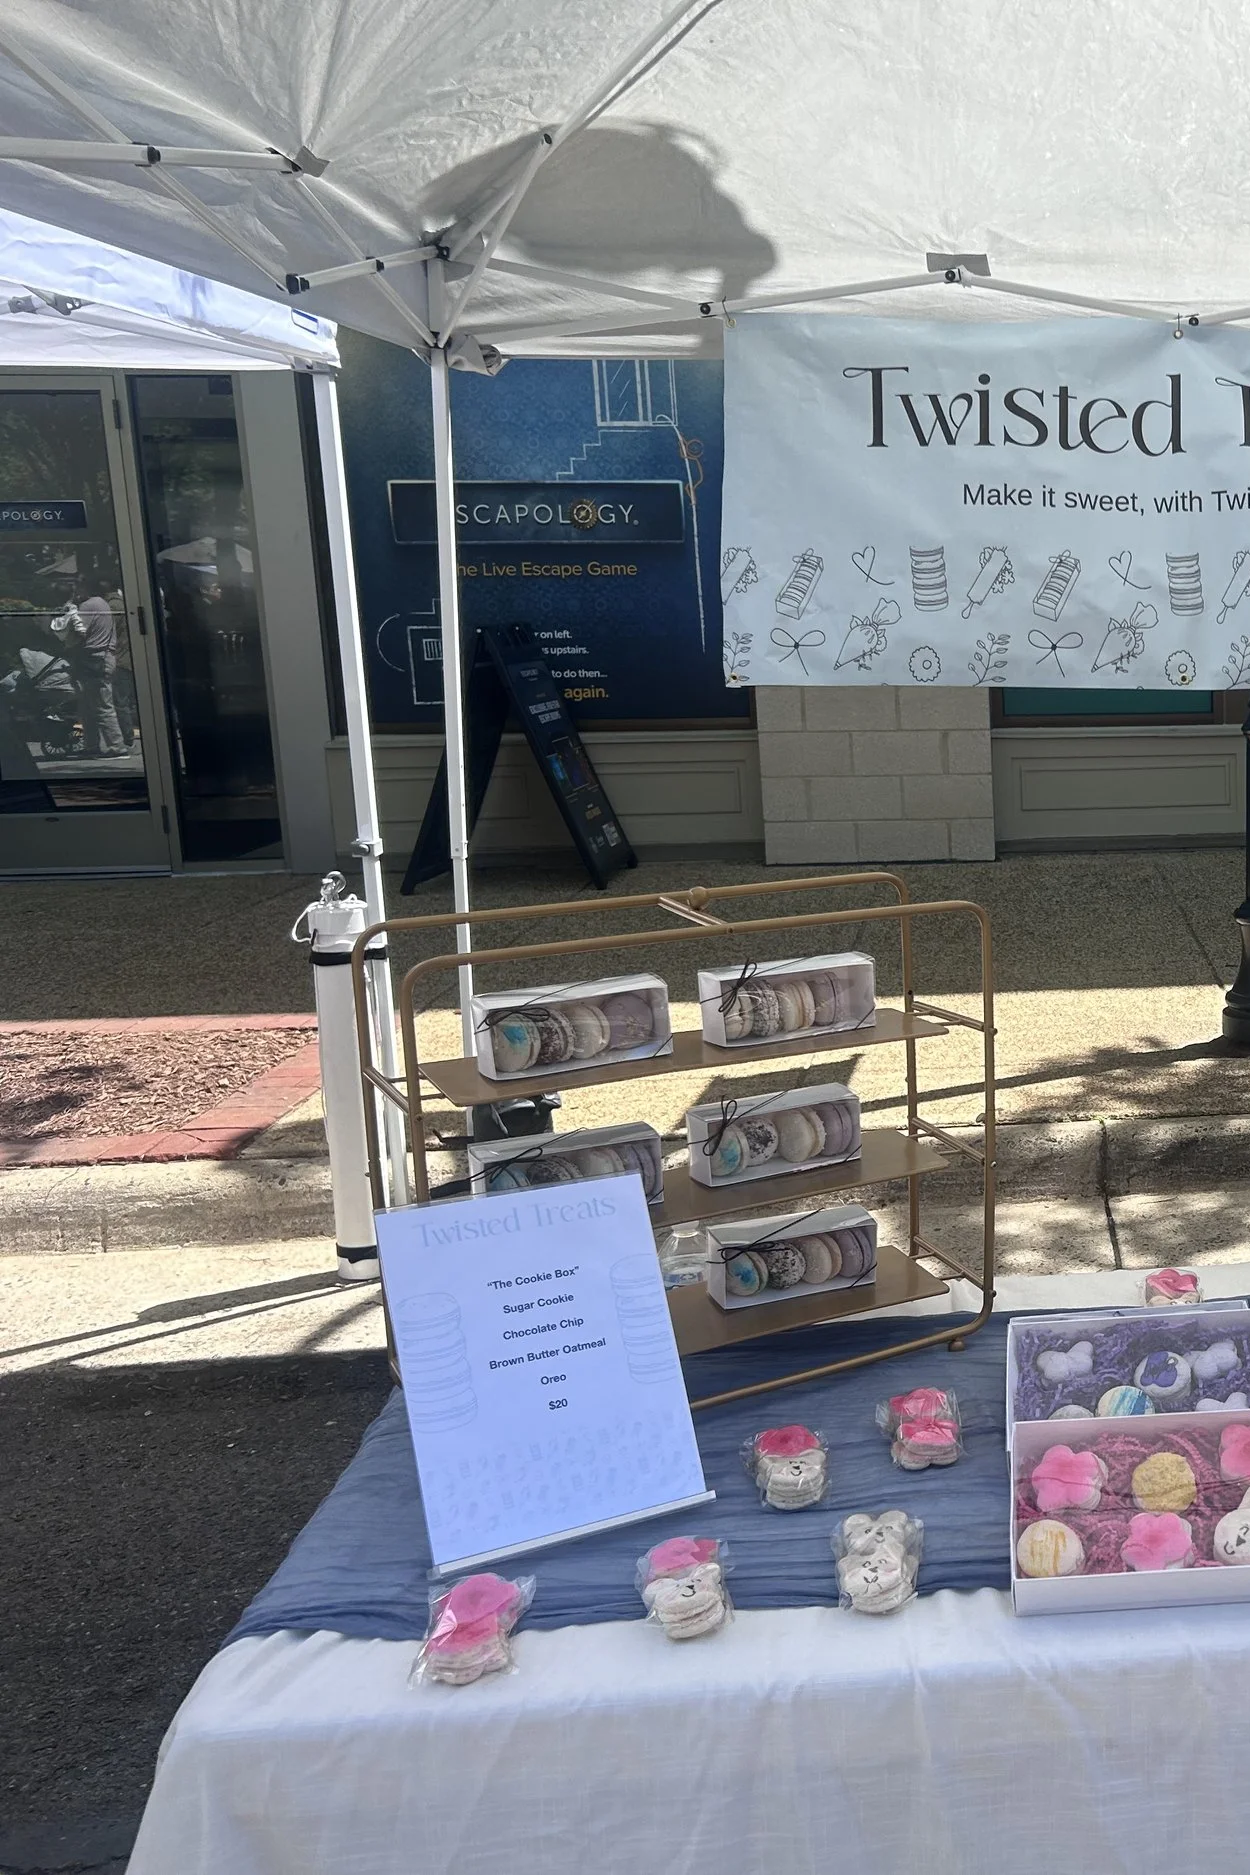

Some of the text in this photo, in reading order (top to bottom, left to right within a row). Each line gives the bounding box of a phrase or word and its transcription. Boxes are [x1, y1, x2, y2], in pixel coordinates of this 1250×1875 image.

[843, 366, 1187, 457] Twisted
[963, 483, 1033, 506] Make
[1041, 484, 1056, 508] it
[1064, 490, 1145, 516] sweet,
[1154, 488, 1202, 513] with
[0, 510, 64, 521] POLOGY
[456, 503, 639, 525] SCAPOLOGY
[457, 561, 638, 580] he Live Escape Game
[540, 631, 553, 639] on
[554, 629, 572, 639] left.
[550, 645, 589, 656] upstairs.
[552, 669, 562, 678] to
[563, 668, 577, 678] do
[564, 685, 609, 701] again.
[412, 1196, 617, 1248] Twisted Treats
[515, 1271, 552, 1286] Cookie
[503, 1292, 574, 1315] Sugar Cookie
[502, 1316, 584, 1340] Chocolate Chip
[489, 1337, 607, 1370] Brown Butter Oatmeal
[540, 1373, 567, 1386] Oreo
[548, 1398, 568, 1410] $20
